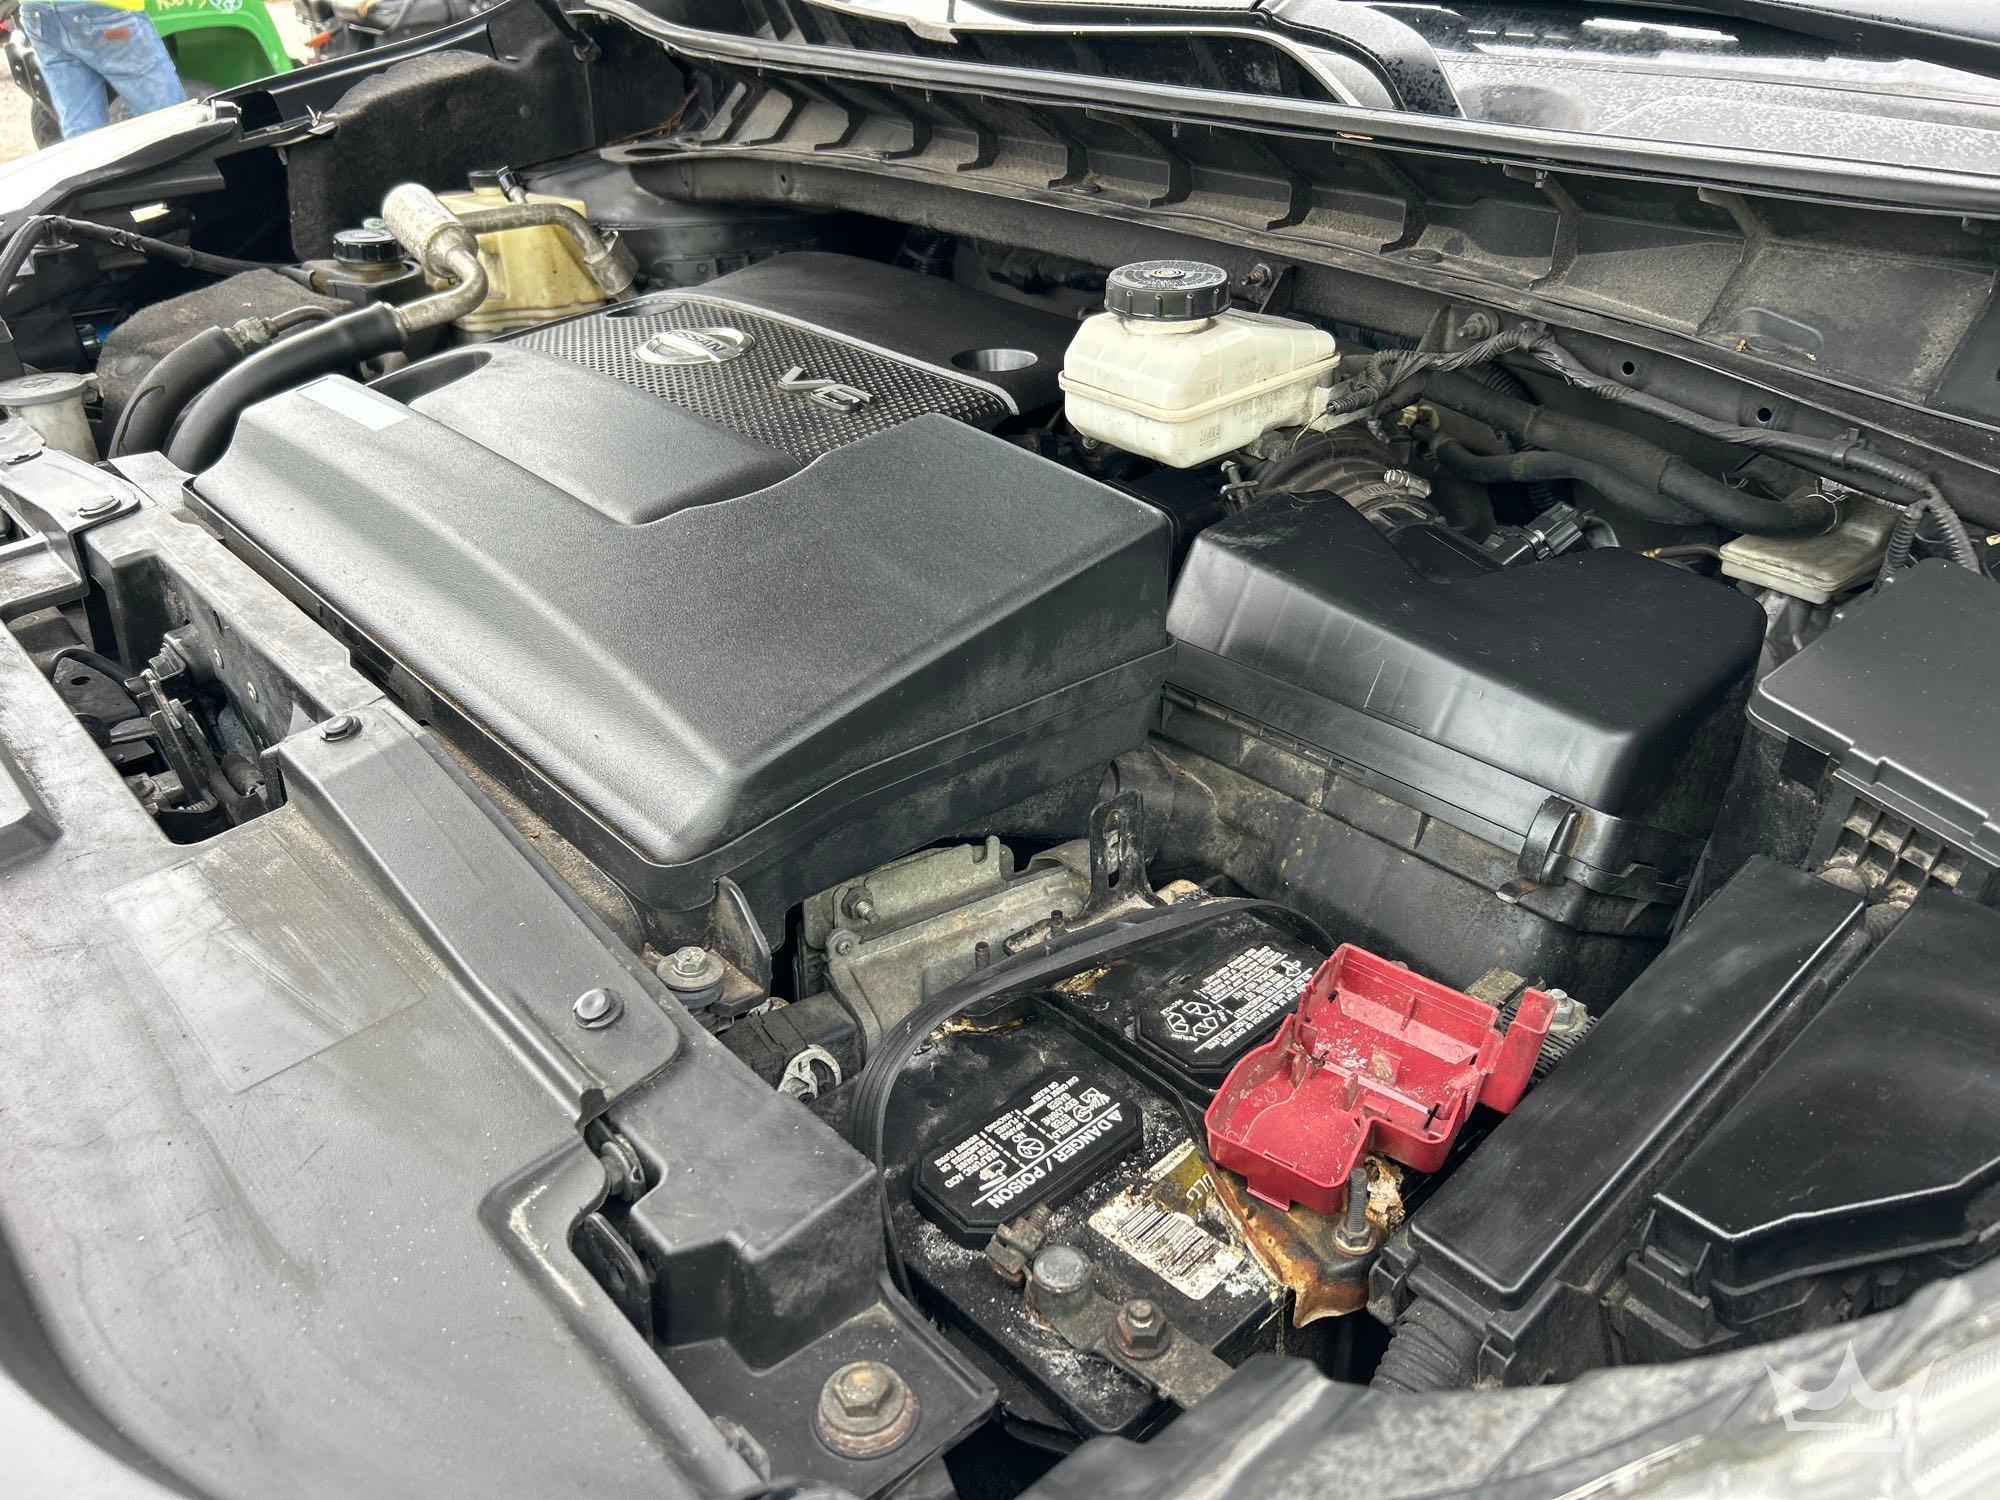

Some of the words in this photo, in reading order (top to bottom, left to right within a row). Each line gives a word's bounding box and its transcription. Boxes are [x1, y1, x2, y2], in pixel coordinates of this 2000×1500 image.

[664, 329, 728, 352] NISSAN
[777, 366, 873, 411] V6
[1205, 1036, 1223, 1050] LEVEL
[1220, 1029, 1233, 1039] AND
[1220, 1027, 1247, 1048] CHILDREN
[1039, 1097, 1080, 1126] EXPLOSIVE
[1045, 1092, 1073, 1111] GASES
[983, 1112, 1014, 1133] SMOKING
[1049, 1113, 1072, 1130] EYES
[1050, 1118, 1080, 1139] SHIELD
[1009, 1130, 1028, 1144] NO
[1051, 1118, 1115, 1163] DANGER
[976, 1144, 994, 1157] CAN
[961, 1149, 1001, 1177] SULFURIC
[1039, 1157, 1059, 1172] /
[942, 1172, 966, 1189] ACID
[986, 1165, 1047, 1209] POISON
